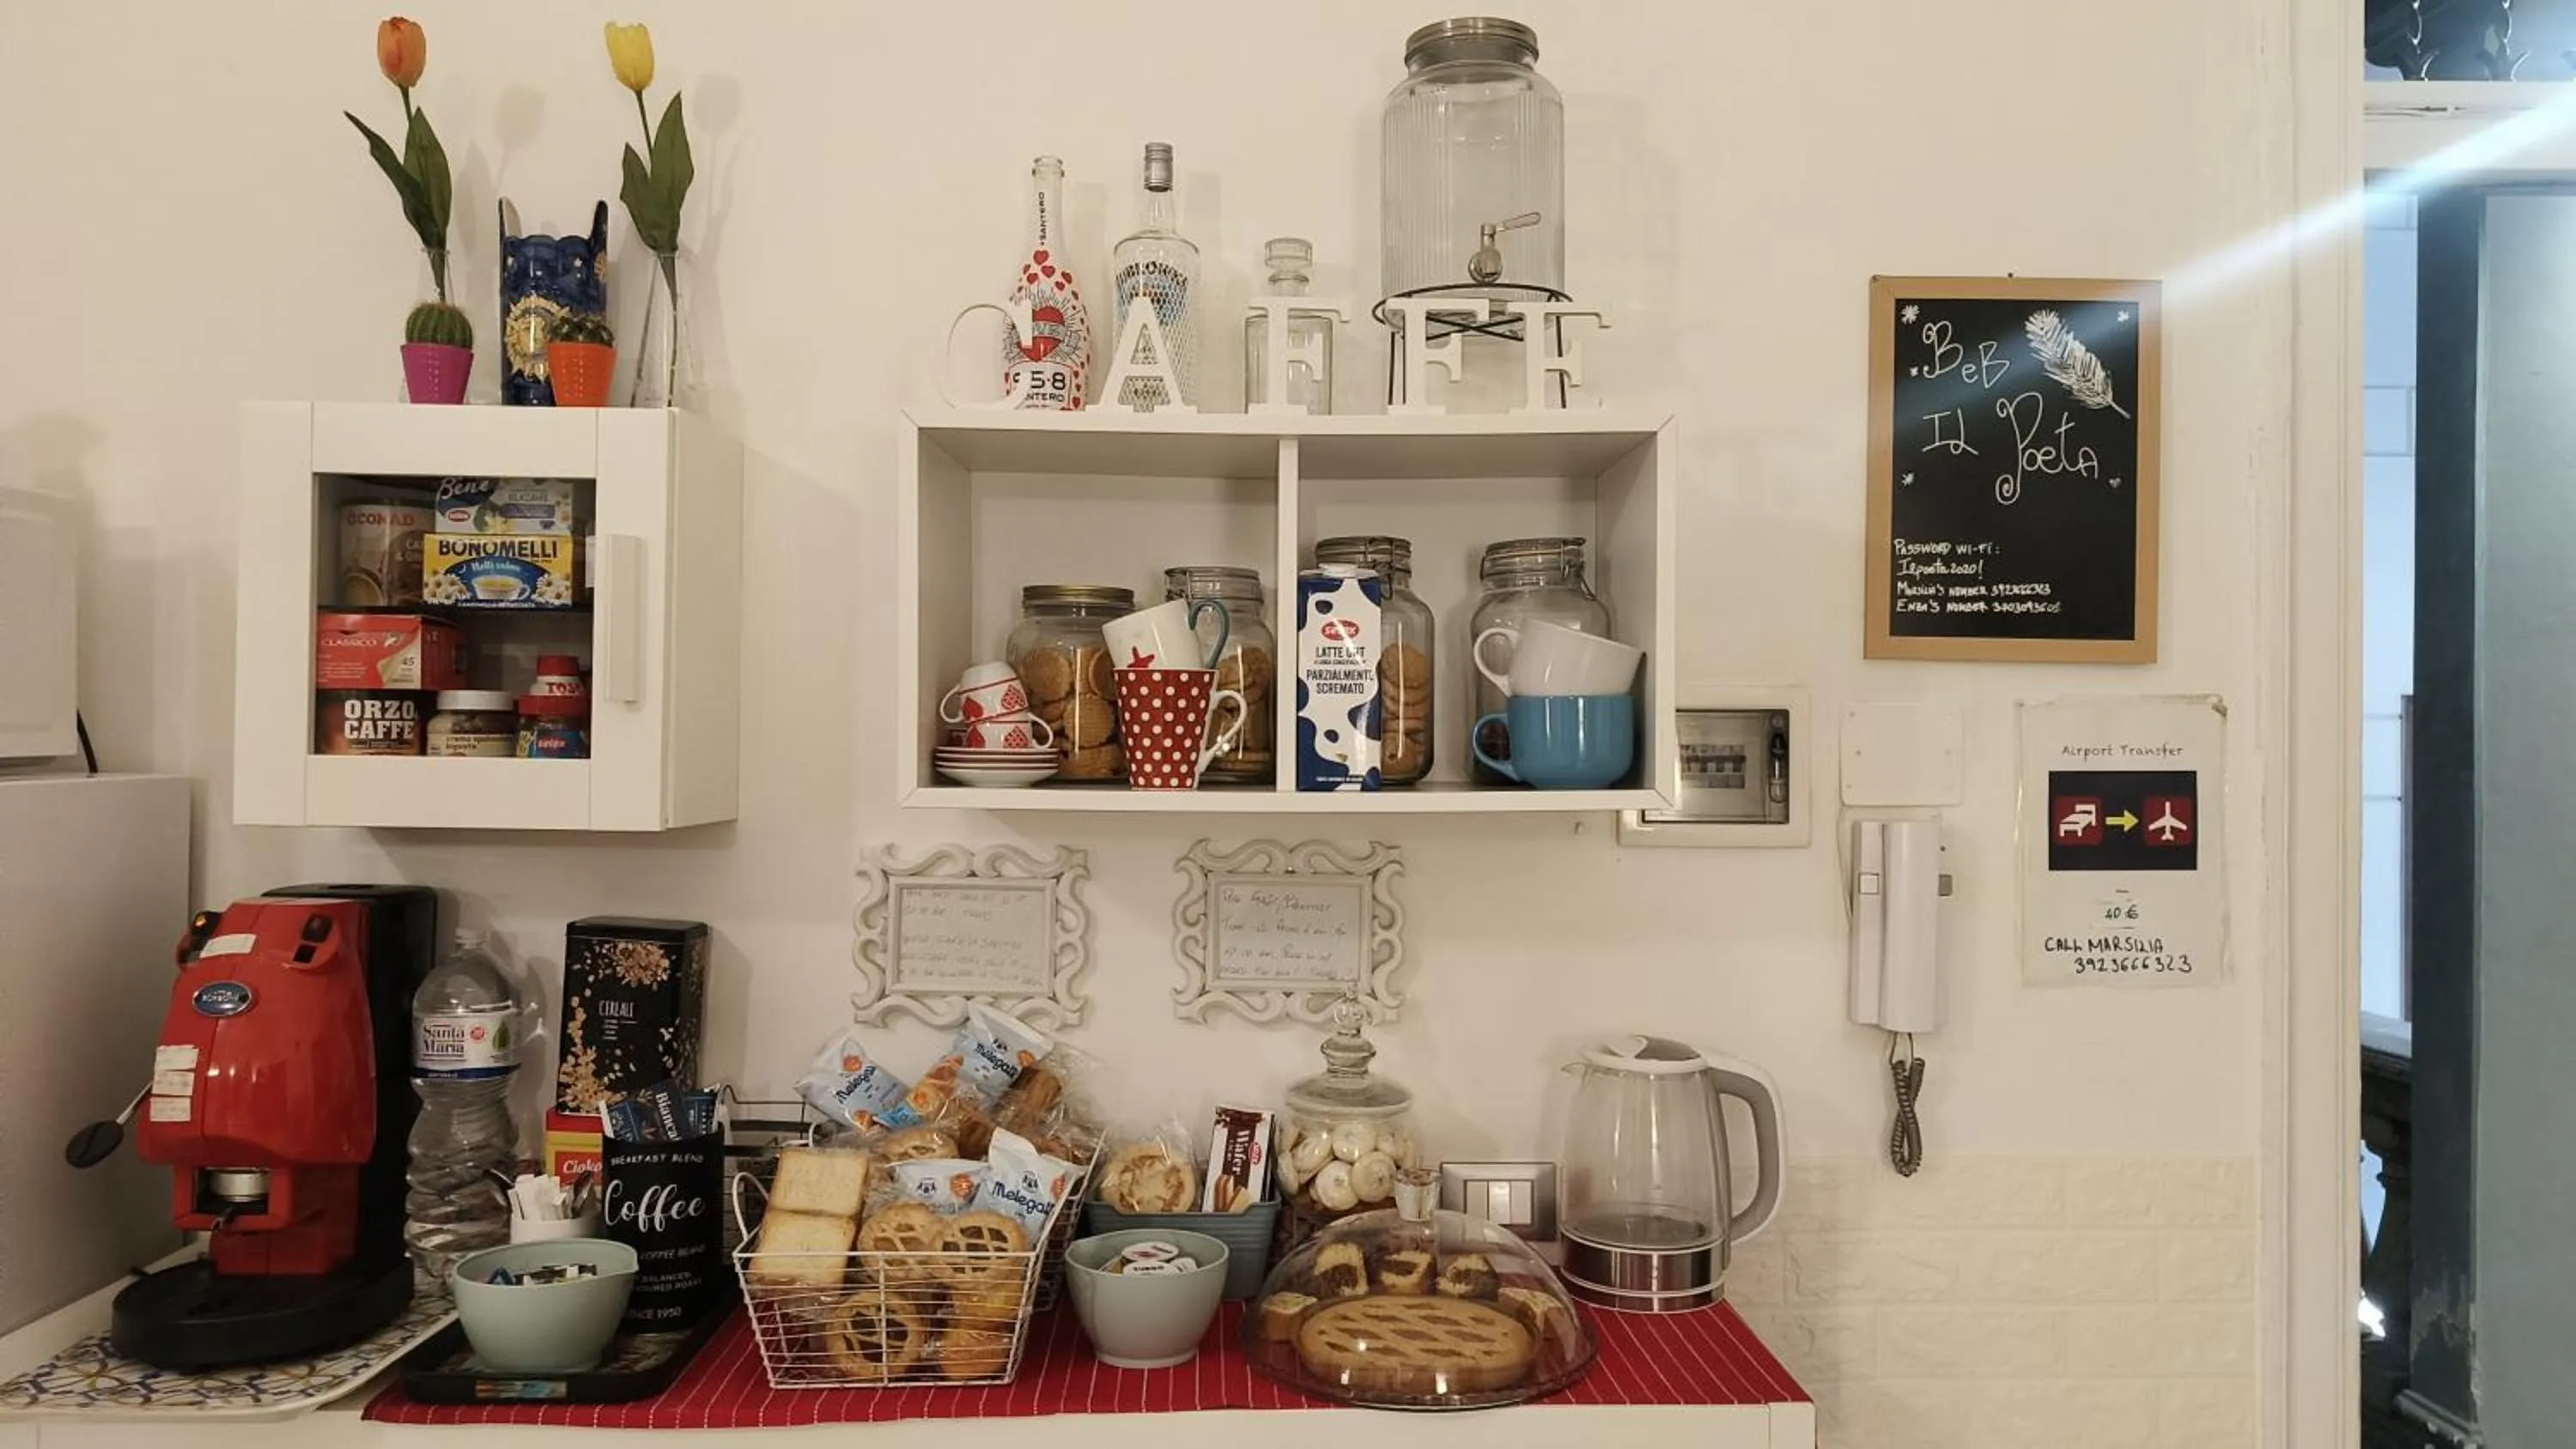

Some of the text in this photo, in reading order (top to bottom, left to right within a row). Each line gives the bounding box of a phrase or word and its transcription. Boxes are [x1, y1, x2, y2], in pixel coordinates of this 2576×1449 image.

[1025, 392, 1065, 402] NTERO
[439, 539, 557, 559] BONOMELLI
[1315, 646, 1344, 658] LATTE
[402, 657, 416, 666] 45
[1316, 682, 1364, 694] SCREMATO
[344, 700, 416, 719] ORZO
[2062, 744, 2184, 762] Airport Transfer
[2125, 905, 2139, 919] €
[2044, 937, 2082, 953] CALL
[598, 1000, 635, 1017] CEREALI
[423, 1025, 465, 1038] Santa
[423, 1039, 465, 1052] Maria
[1232, 1130, 1251, 1175] Wafer
[611, 1155, 704, 1166] BREAKFAST BLEND
[604, 1179, 707, 1233] Coffee
